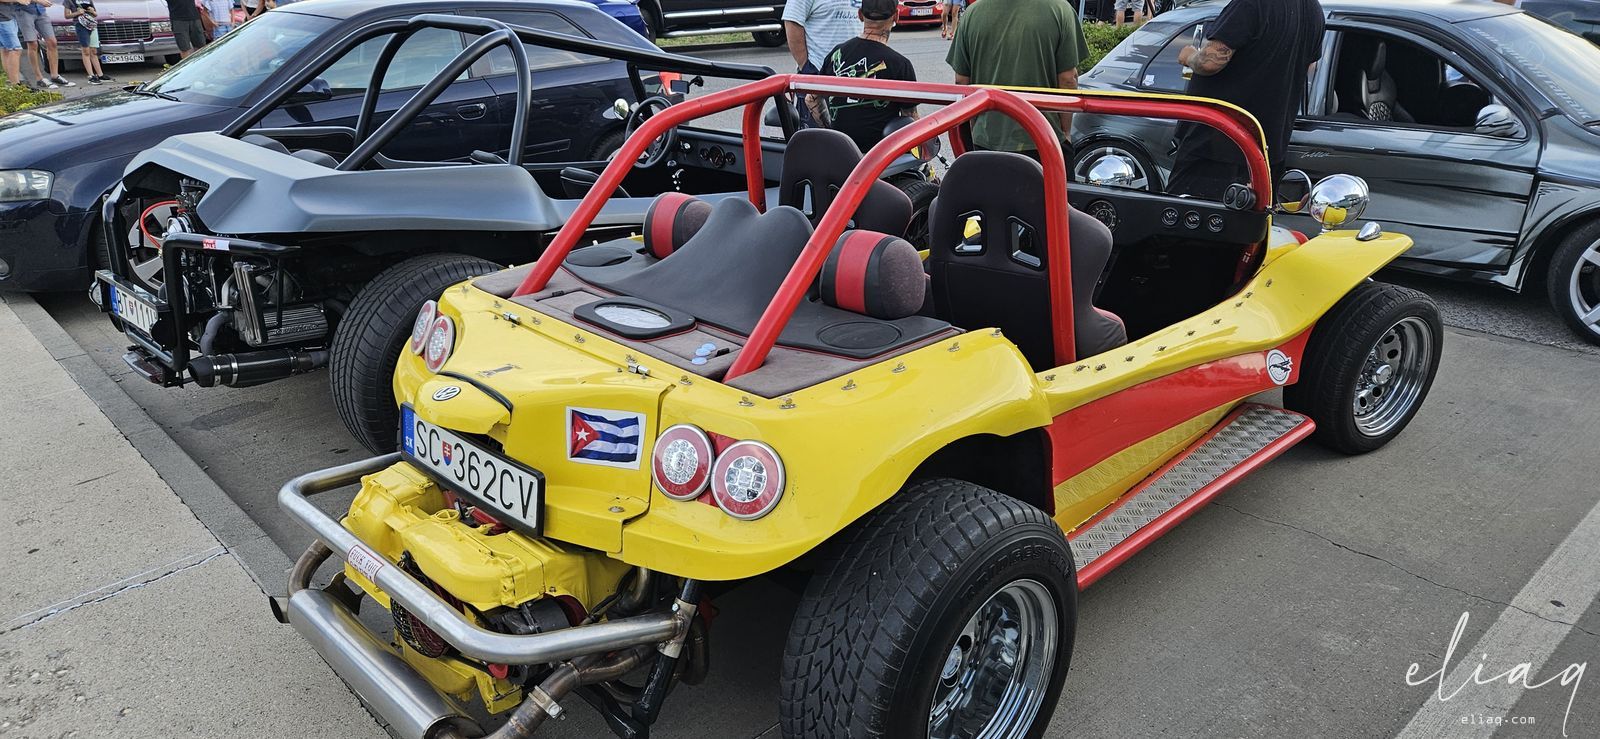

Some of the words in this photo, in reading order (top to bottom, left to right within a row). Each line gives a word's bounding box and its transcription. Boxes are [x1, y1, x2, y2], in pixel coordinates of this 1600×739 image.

[404, 435, 414, 451] SK
[415, 420, 441, 467] SC
[453, 442, 534, 520] 362CV
[349, 548, 366, 566] FUCK
[364, 559, 379, 575] YOU
